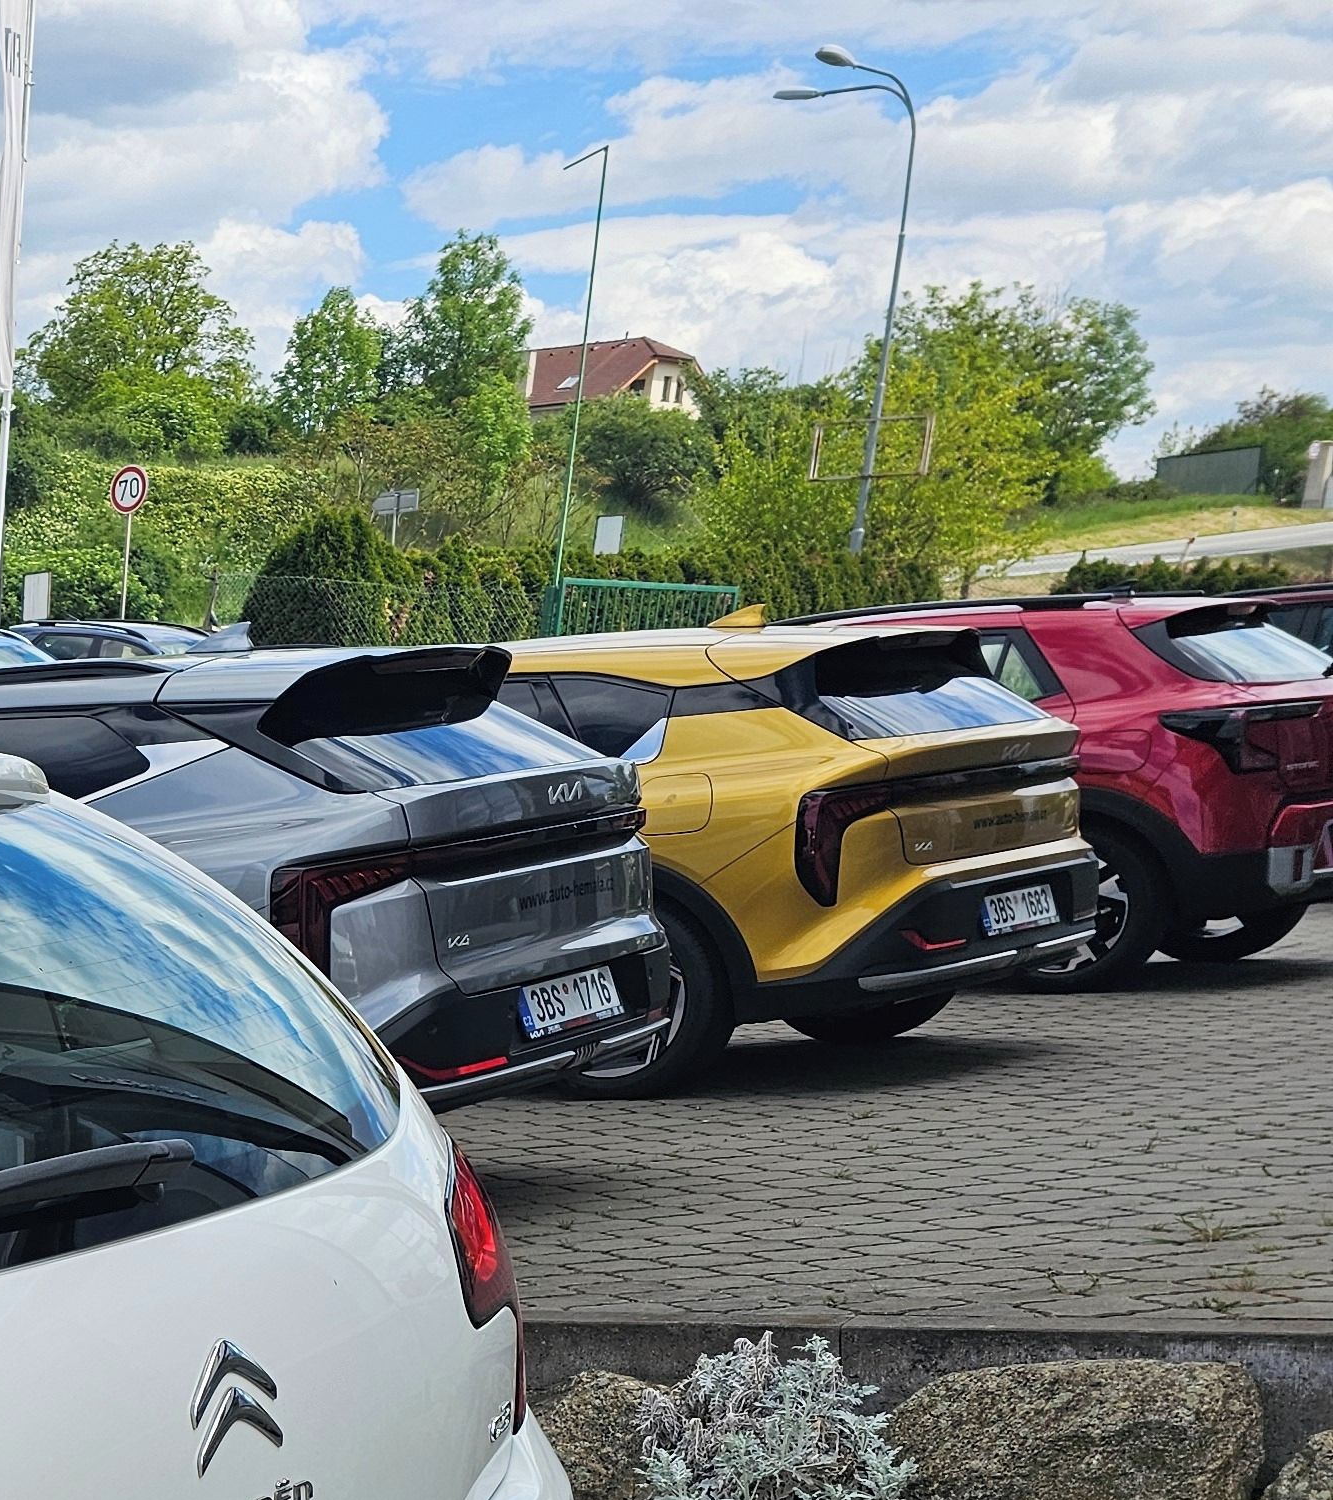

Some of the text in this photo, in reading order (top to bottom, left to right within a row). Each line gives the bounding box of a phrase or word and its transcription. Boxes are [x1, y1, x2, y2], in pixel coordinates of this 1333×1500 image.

[118, 477, 139, 501] 70
[990, 888, 1050, 924] 3BS 1683
[530, 971, 611, 1022] 3BS 1716
